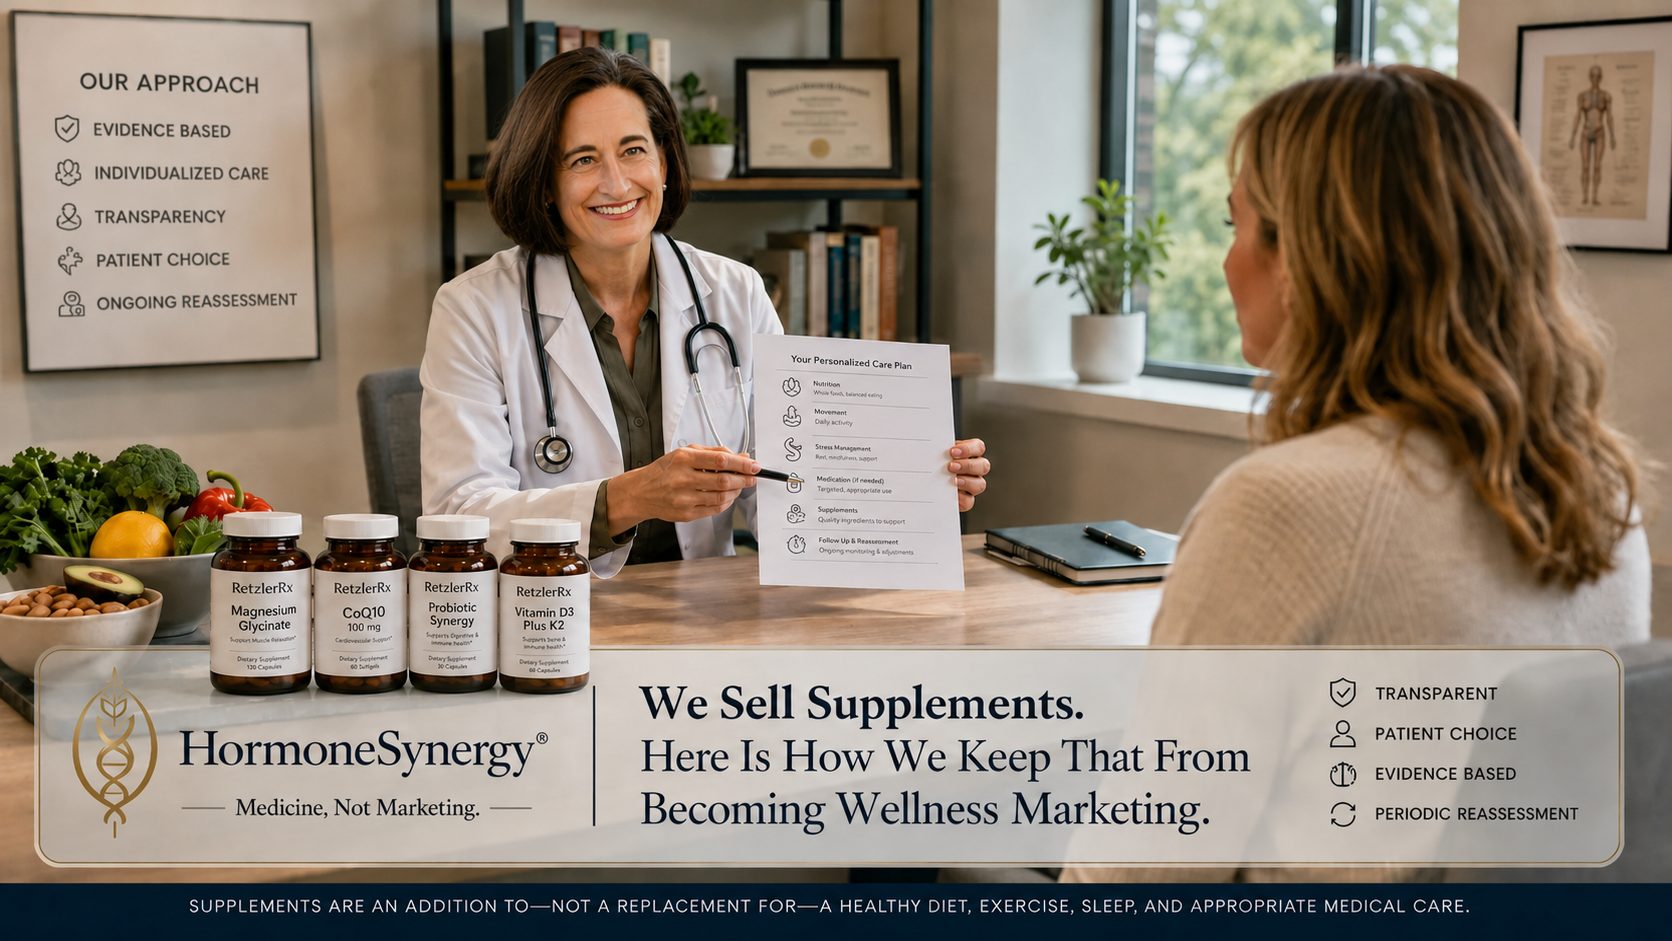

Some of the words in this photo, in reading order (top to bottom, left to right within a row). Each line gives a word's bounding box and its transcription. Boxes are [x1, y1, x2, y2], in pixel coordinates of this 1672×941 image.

[80, 73, 128, 90] OUR
[137, 74, 258, 93] APPROACH
[94, 123, 174, 137] EVIDENCE
[181, 124, 231, 138] BASED
[95, 166, 223, 180] INDIVIDUALIZED
[229, 167, 269, 180] CARE
[95, 210, 225, 223] TRANSPARENCY
[97, 253, 162, 267] PATIENT
[167, 253, 229, 266] CHOICE
[97, 296, 176, 310] ONGOING
[182, 293, 297, 308] REASSESSMENT
[791, 355, 811, 363] Your
[814, 357, 869, 367] Personalized
[872, 360, 892, 368] Care
[894, 361, 912, 370] Plan
[813, 380, 841, 388] Nutrition
[814, 408, 847, 416] Movement
[815, 418, 830, 426] Daily
[817, 486, 845, 494] Targeted,
[846, 486, 881, 494] appropriate
[818, 506, 858, 514] Supplements
[818, 516, 840, 525] Quality
[841, 517, 875, 525] ingredients
[841, 537, 850, 545] Up
[819, 547, 844, 555] Ongoing
[845, 548, 875, 556] monitoring
[882, 549, 914, 557] adjustments
[232, 582, 292, 594] RetzlerRx
[335, 582, 390, 594] RetzlerRx
[425, 582, 478, 592] RetzlerRx
[517, 586, 571, 597] RetzlerRx
[231, 605, 297, 619] Magnesium
[343, 606, 385, 619] CoQ10
[429, 602, 477, 613] Probiotic
[515, 607, 555, 617] Vitamin
[560, 607, 574, 617] D3
[430, 615, 475, 628] Synergy
[524, 620, 546, 630] Plus
[550, 620, 564, 630] K2
[239, 620, 291, 634] Glycinate
[348, 623, 364, 631] 100
[258, 655, 290, 663] Supplement
[339, 655, 358, 663] Dietary
[428, 655, 446, 663] Dietary
